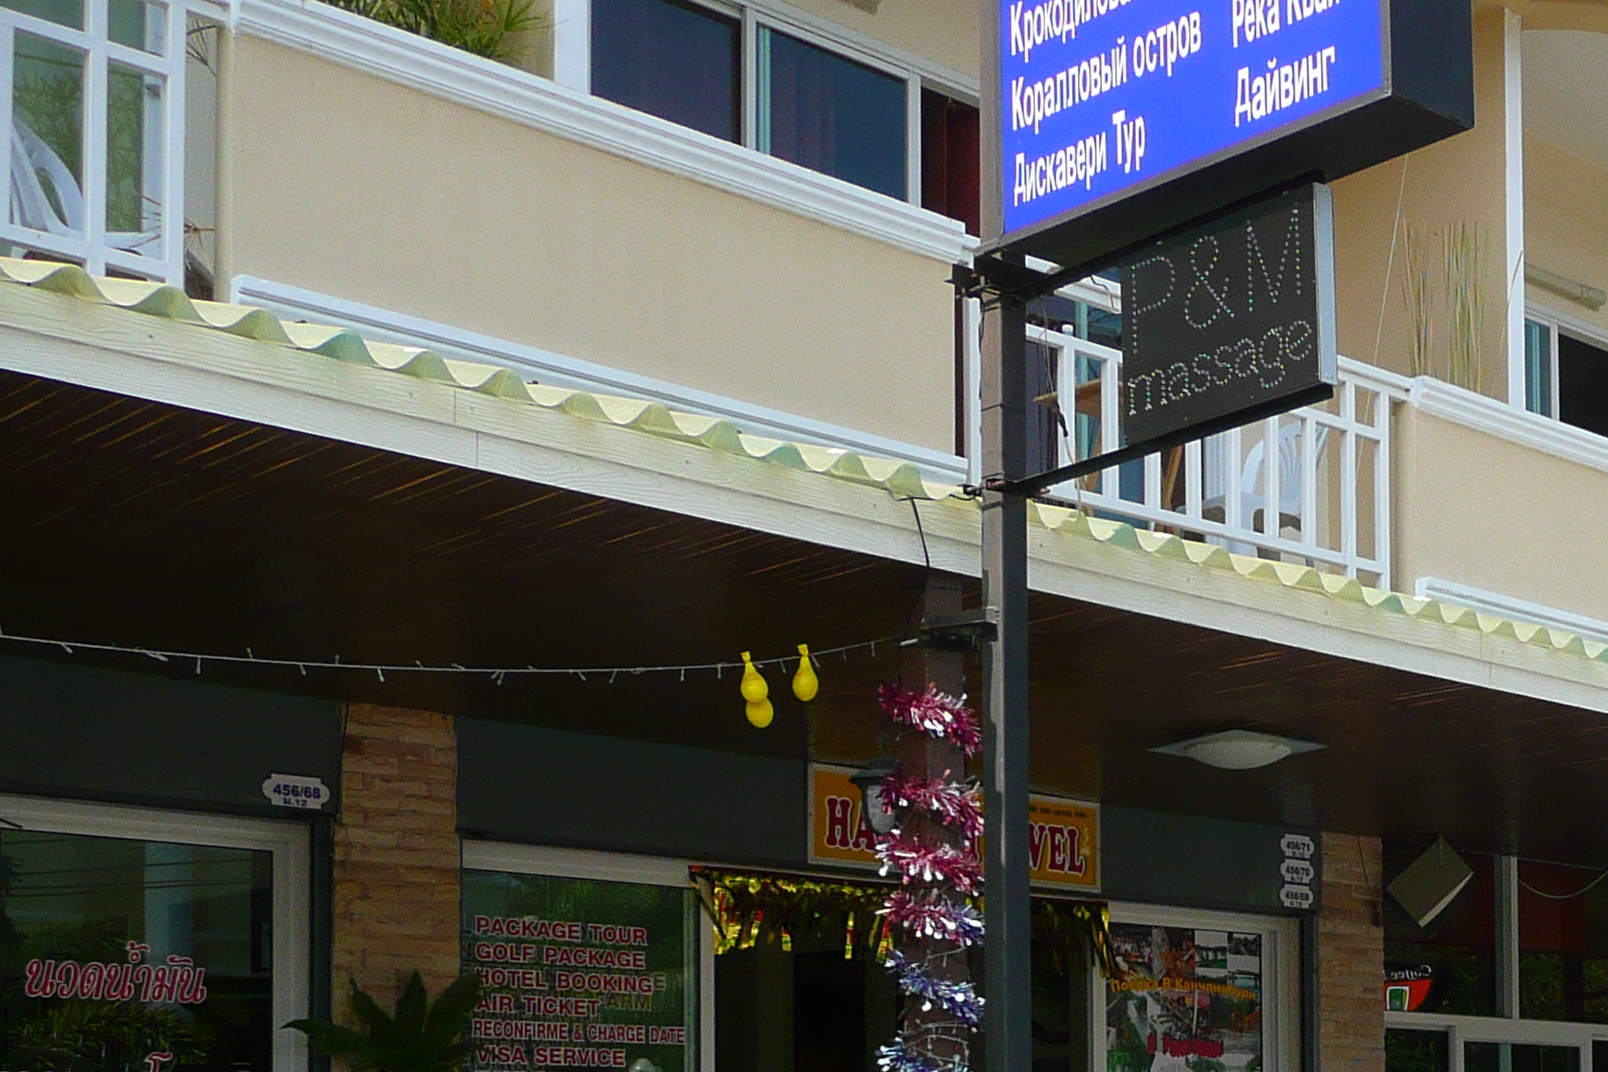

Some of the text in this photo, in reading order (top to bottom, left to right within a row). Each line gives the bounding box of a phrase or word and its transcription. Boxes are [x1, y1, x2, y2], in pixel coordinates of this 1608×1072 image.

[1011, 12, 1202, 134] Коралловый остров
[1234, 46, 1337, 127] Дайвинг
[1012, 109, 1147, 207] Дискавери Тур
[1127, 319, 1312, 416] massage
[273, 784, 321, 799] 456/68
[475, 915, 648, 946] PACKAGE TOUR
[475, 943, 646, 969] GOLF PACKAGE
[26, 941, 207, 1004] นวดน้ำมัน
[475, 969, 654, 995] HOTEL BOOKING
[474, 995, 513, 1015] AIR
[523, 997, 601, 1017] TICKET
[472, 1019, 686, 1045] RECONFIRME & CHARGE DATE
[475, 1046, 627, 1068] VISA SERVICE
